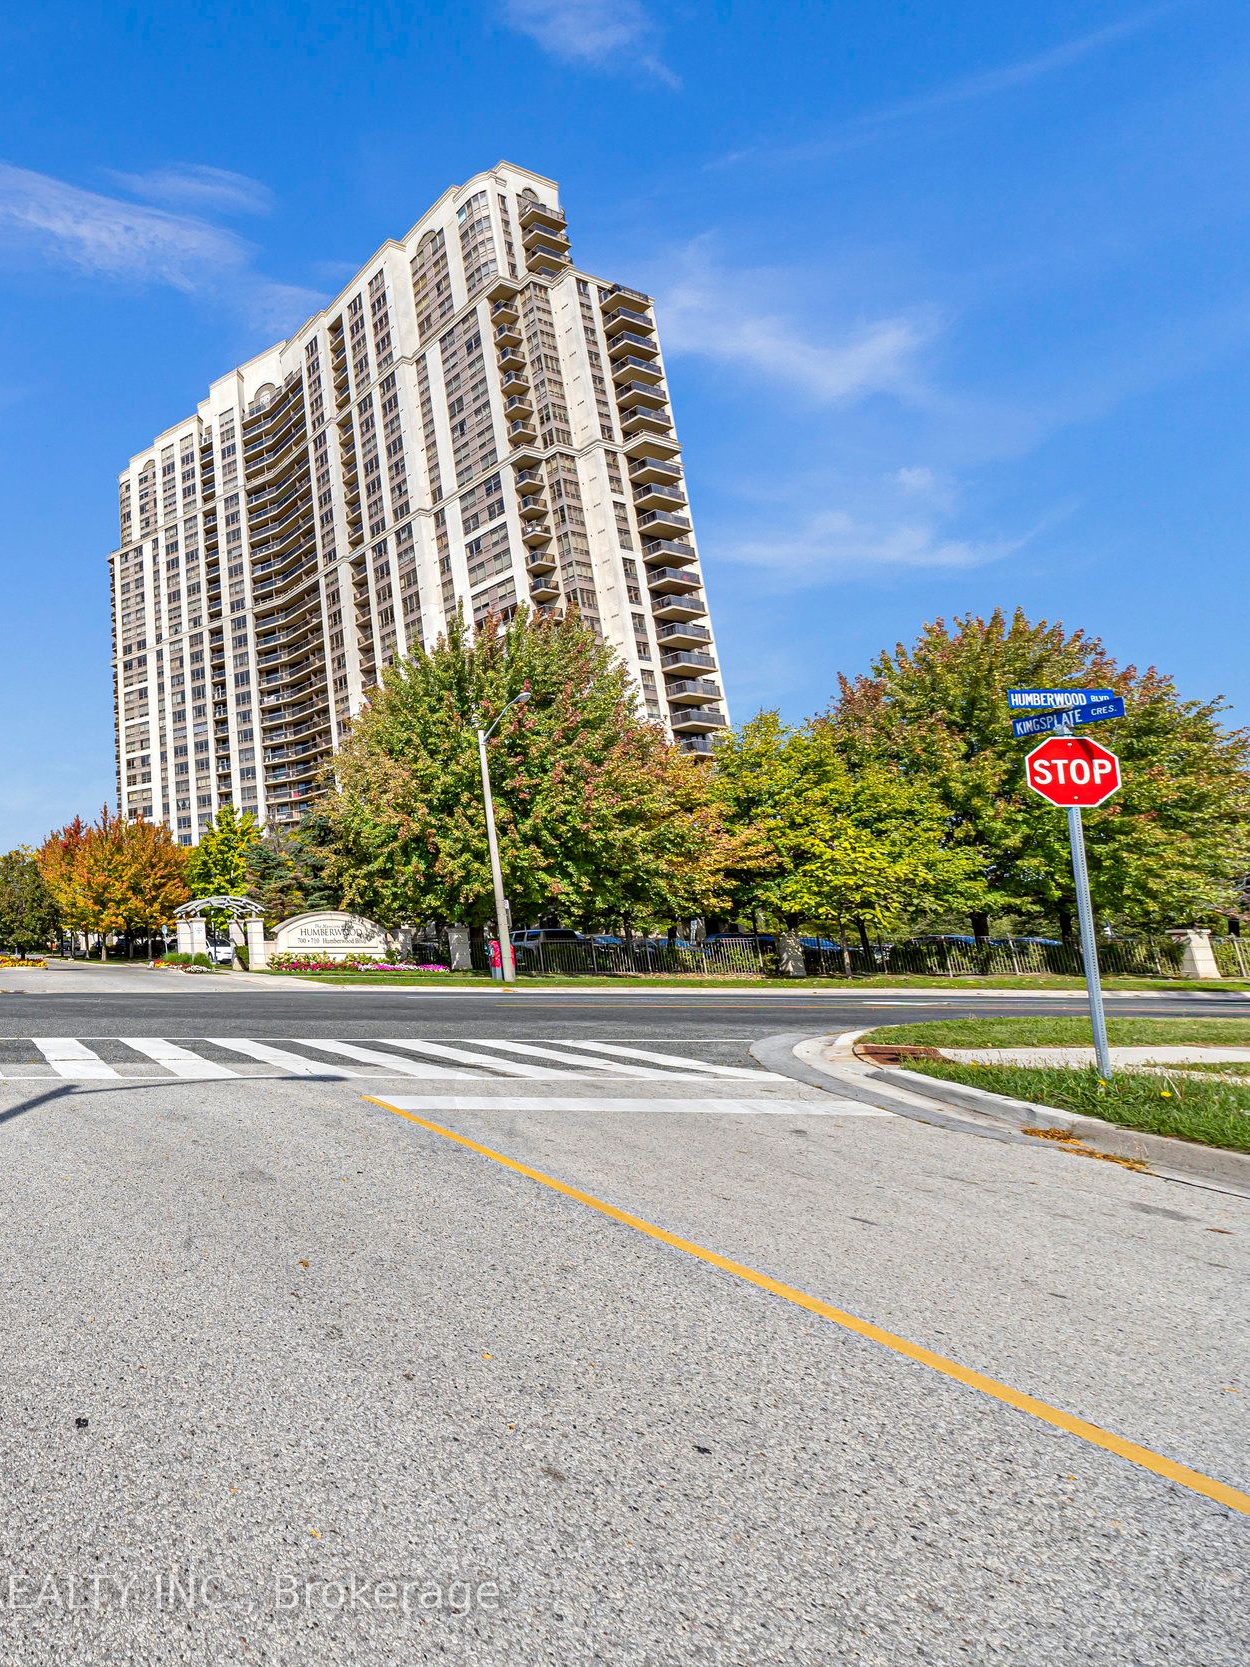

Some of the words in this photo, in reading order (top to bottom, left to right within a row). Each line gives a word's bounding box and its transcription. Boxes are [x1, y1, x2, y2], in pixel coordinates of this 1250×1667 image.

[1010, 693, 1087, 706] HUMBERWOOD
[1015, 709, 1083, 735] KINGSPLATE
[1091, 704, 1117, 716] CRES.
[1033, 759, 1112, 785] STOP
[300, 928, 362, 936] HUMBERWOOD
